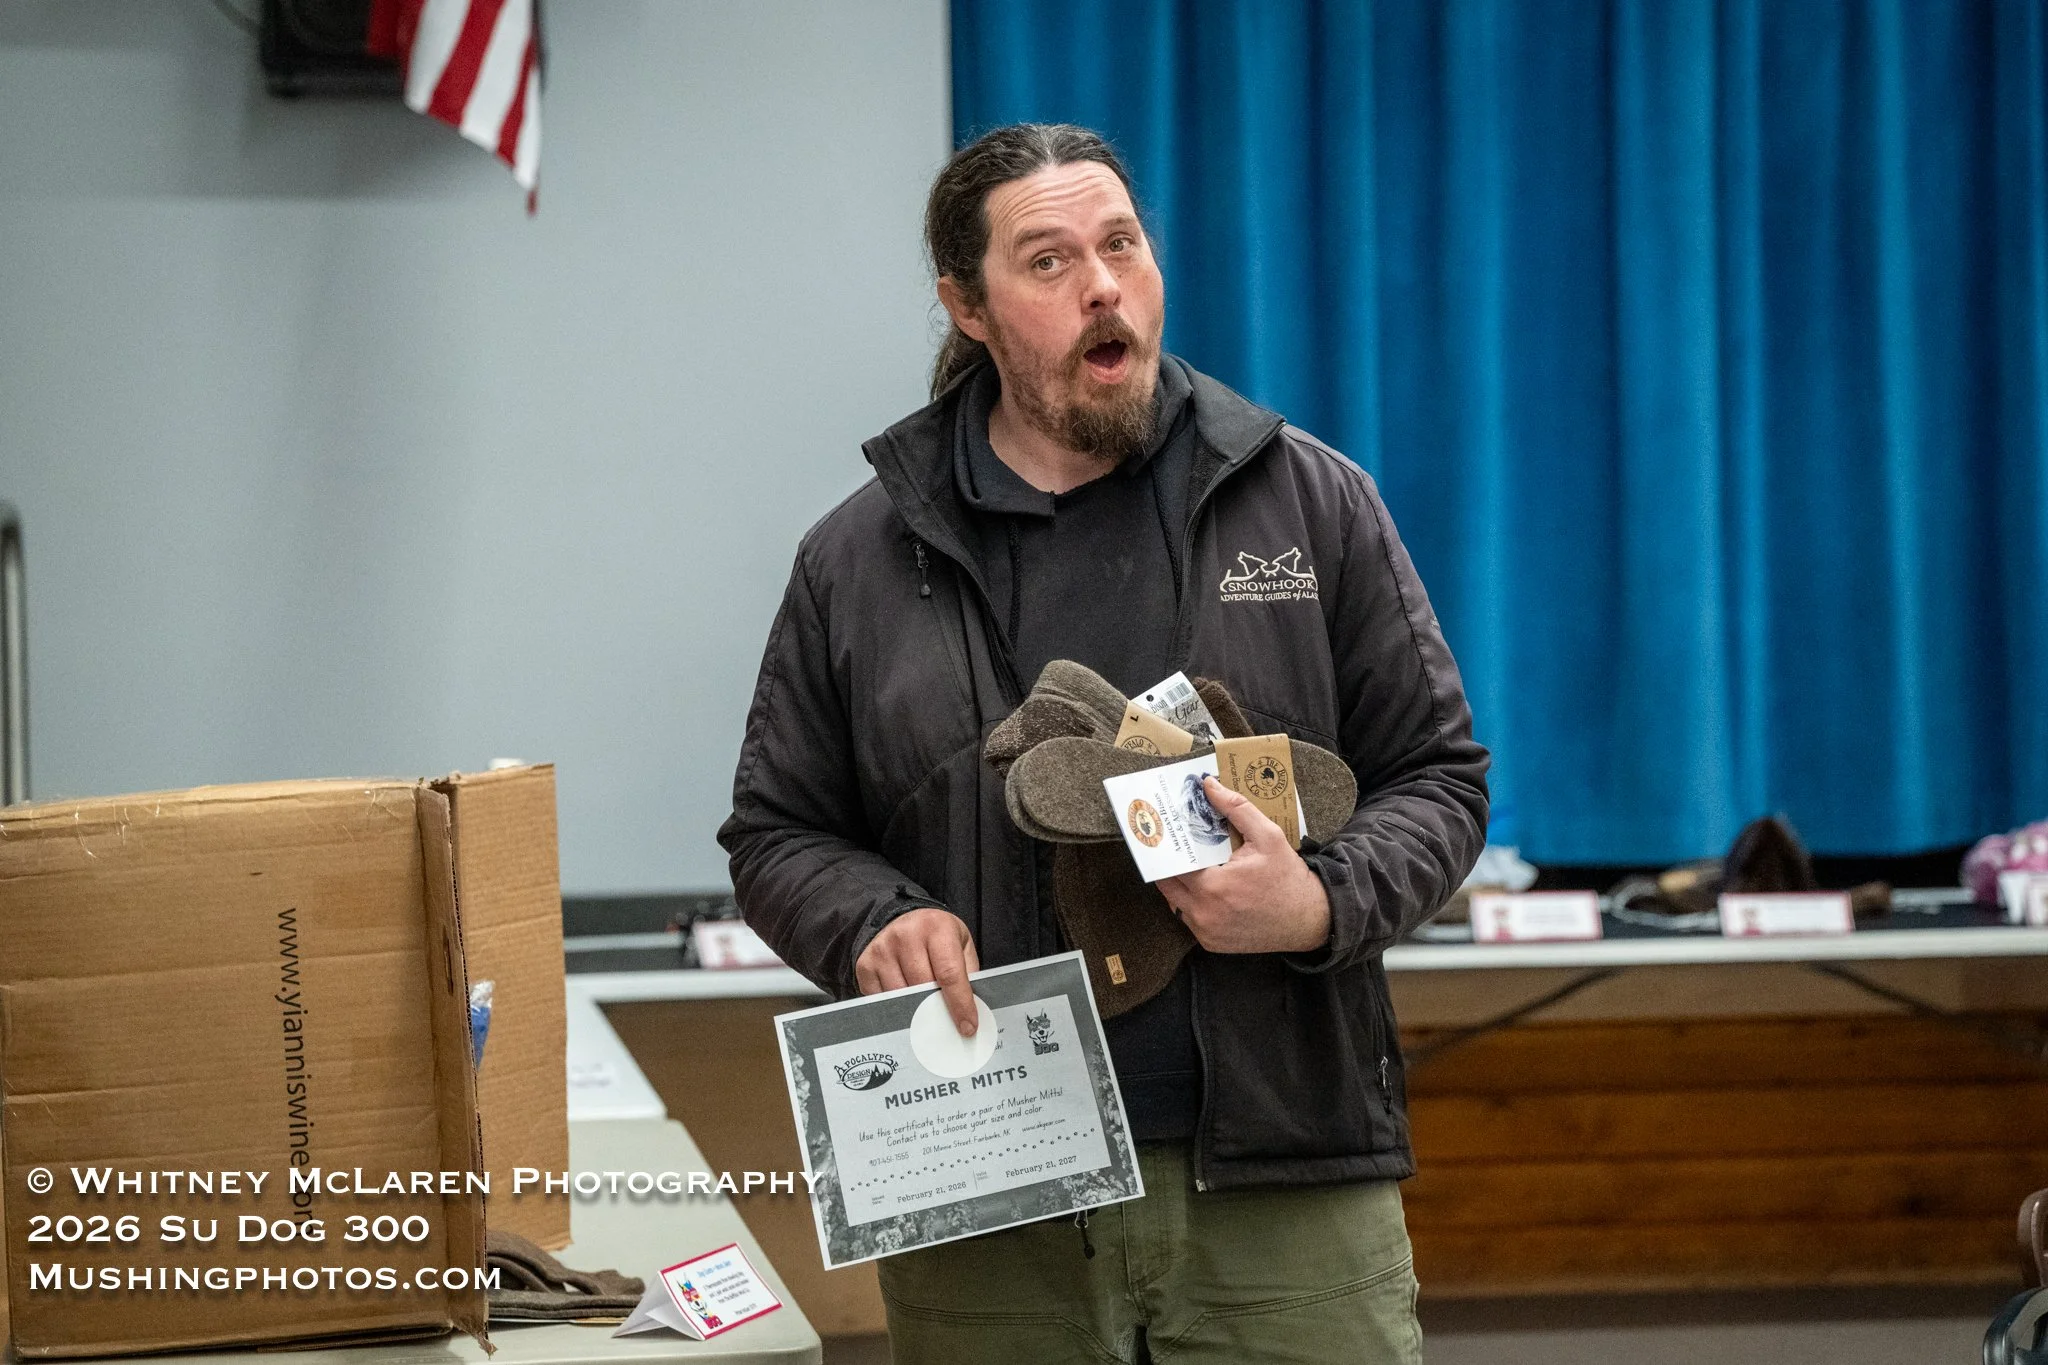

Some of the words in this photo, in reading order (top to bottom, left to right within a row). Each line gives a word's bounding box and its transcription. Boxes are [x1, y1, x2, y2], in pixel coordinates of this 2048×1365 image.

[1228, 579, 1315, 592] SNOWHOOK
[1264, 592, 1292, 600] GUIDES
[1293, 590, 1301, 601] of
[1175, 700, 1199, 725] Gear
[1228, 752, 1238, 778] American
[1246, 764, 1257, 781] WOOL
[1266, 758, 1278, 769] THE
[1270, 768, 1286, 796] BUFFALO
[274, 908, 313, 1236] www.yianniswineom
[834, 1054, 899, 1079] APOCALYPSE
[847, 1068, 872, 1080] DESIGN
[885, 1082, 960, 1109] MUSHER
[972, 1066, 1028, 1090] MITTS
[860, 1132, 874, 1142] Use
[878, 1128, 890, 1138] this
[894, 1117, 934, 1134] certificate
[937, 1114, 944, 1124] to
[948, 1110, 968, 1122] order
[979, 1106, 994, 1119] pair
[996, 1100, 1005, 1110] of
[1008, 1094, 1037, 1108] Musher
[1040, 1087, 1063, 1100] Mitts!
[887, 1132, 916, 1146] Contact
[932, 1126, 940, 1136] to
[943, 1124, 968, 1134] choose
[970, 1119, 988, 1132] your
[991, 1114, 1005, 1122] size
[1008, 1107, 1021, 1119] and
[1006, 1163, 1042, 1178] February
[1058, 1156, 1077, 1166] 2027
[898, 1189, 932, 1204] February
[948, 1182, 967, 1192] 2026
